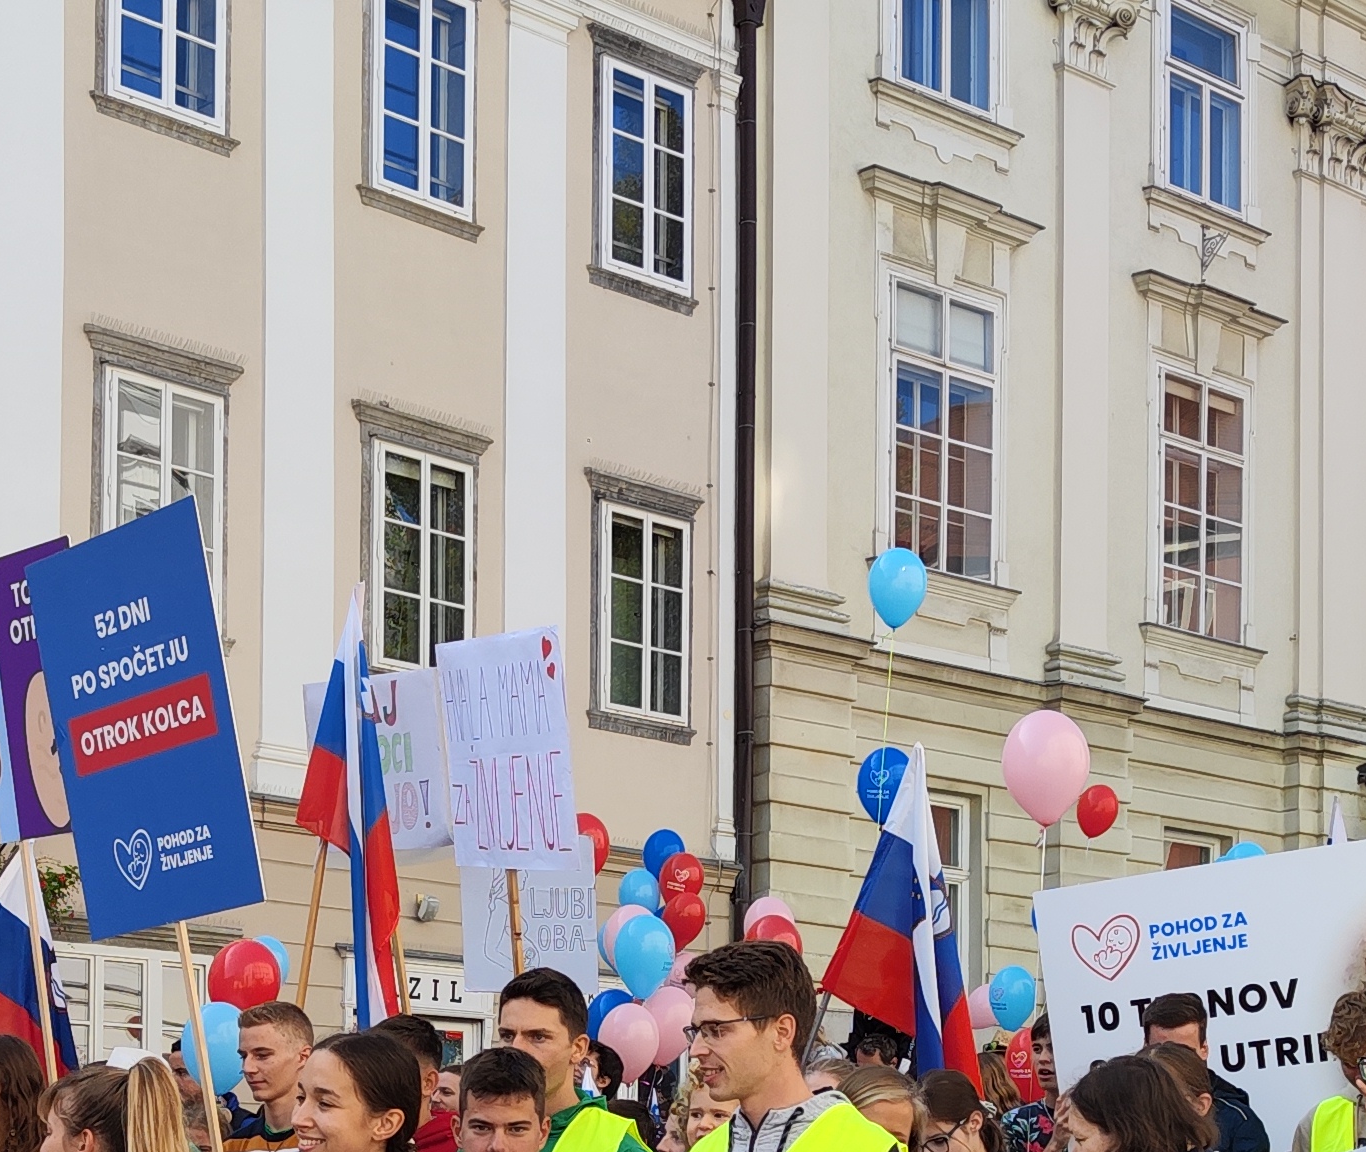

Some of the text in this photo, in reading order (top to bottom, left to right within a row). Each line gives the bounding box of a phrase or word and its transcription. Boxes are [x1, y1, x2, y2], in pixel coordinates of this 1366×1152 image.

[94, 596, 151, 639] 52 DNI
[71, 635, 189, 699] PO SPOČETJU
[497, 660, 551, 737] MAMA
[81, 695, 206, 756] OTROK KOLCA
[157, 825, 211, 851] POHOD ZA
[160, 845, 214, 871] ŽIVLJENJE
[529, 887, 593, 920] LJUBI
[538, 925, 586, 951] OBA
[1149, 912, 1248, 939] POHOD ZA
[1151, 933, 1249, 961] ŽIVLJENJE
[408, 977, 463, 1003] ZIL
[1081, 978, 1299, 1034] 10 TNOV
